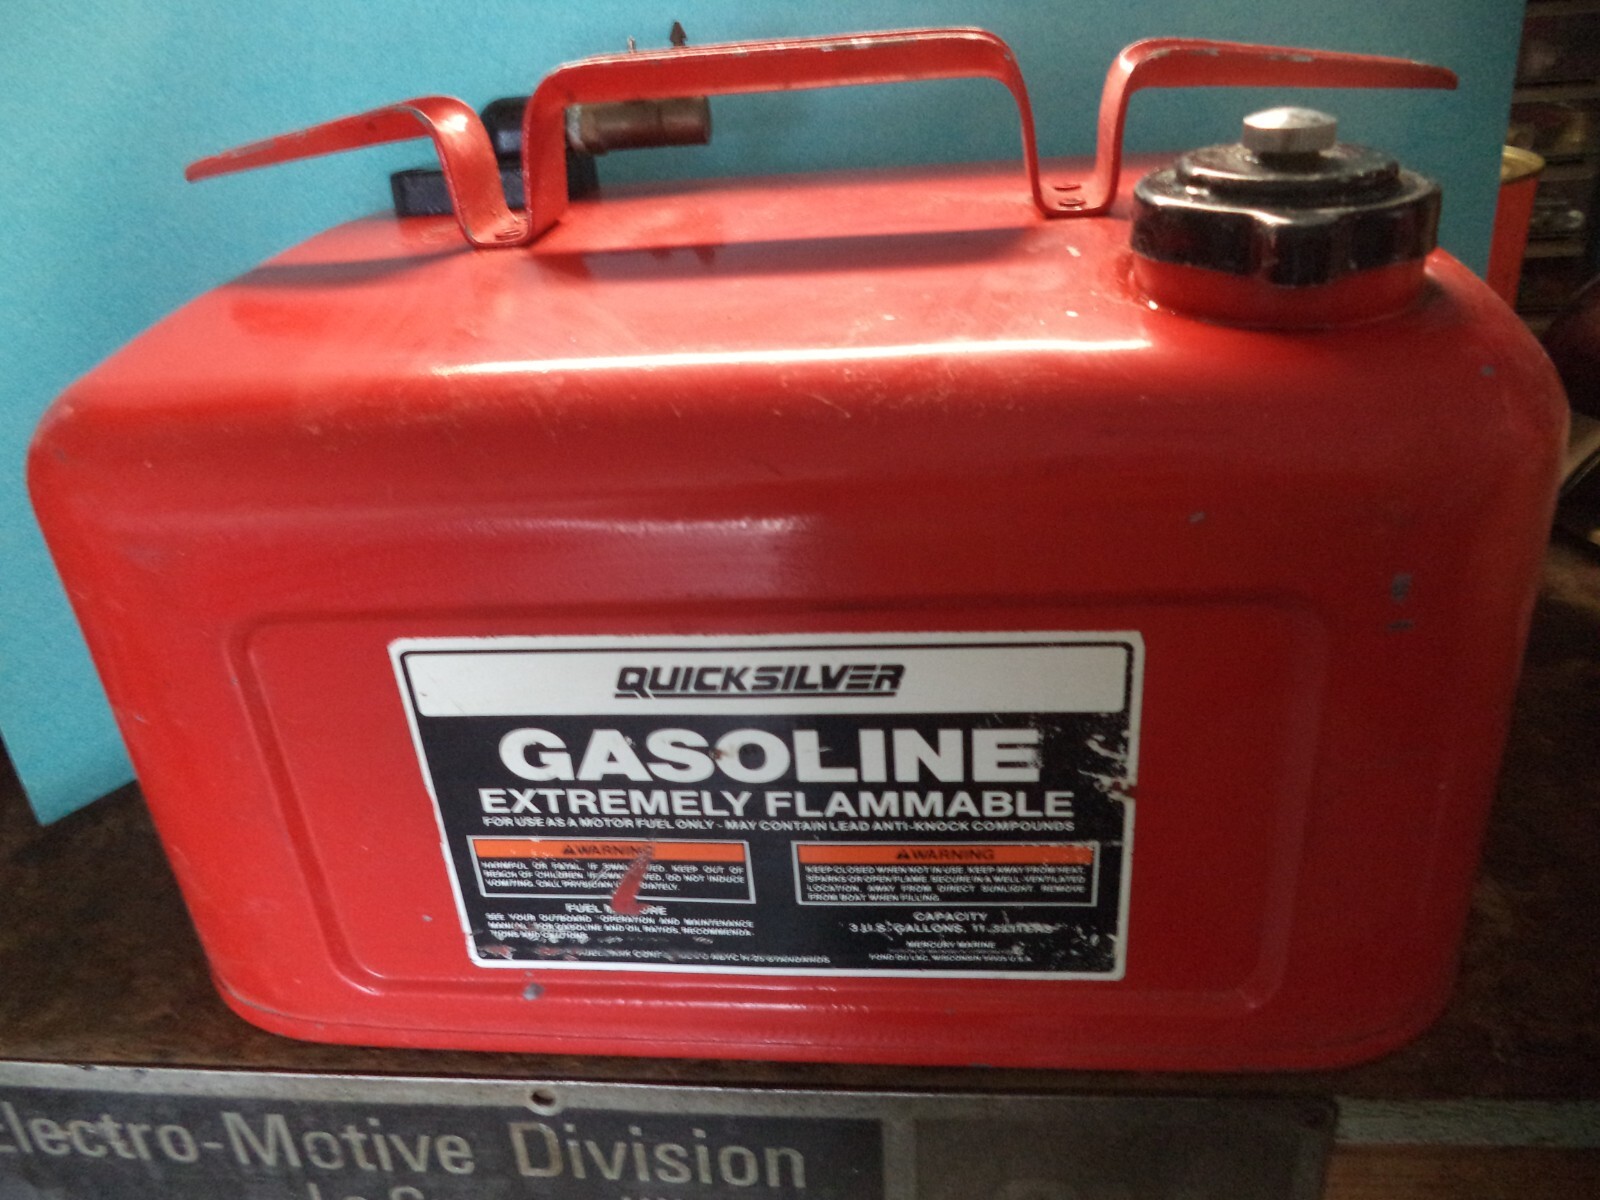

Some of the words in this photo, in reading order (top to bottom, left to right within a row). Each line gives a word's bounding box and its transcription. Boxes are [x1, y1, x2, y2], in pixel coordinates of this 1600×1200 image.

[615, 664, 905, 699] QUICKSILVER
[499, 727, 1040, 784] GASOLINE
[478, 788, 752, 817] EXTREMELY
[763, 790, 1075, 818] FLAMMABLE
[482, 816, 514, 827] FOR
[514, 816, 545, 828] USE
[545, 817, 566, 828] AS
[567, 817, 578, 828] A
[578, 817, 634, 829] MOTOR
[635, 818, 674, 830] FUEL
[674, 818, 715, 830] ONLY
[724, 819, 757, 831] MAY
[758, 819, 828, 832] CONTAIN
[829, 820, 870, 832] LEAD
[871, 820, 969, 832] ANTI-KNOCK
[970, 820, 1075, 832] COMPOUNDS
[911, 849, 994, 860] WARNING
[805, 865, 833, 874] KEEP
[565, 903, 602, 914] FUEL
[912, 911, 988, 921] CAPACITY
[848, 923, 858, 933] 3
[906, 941, 955, 949] MERCURY
[956, 941, 997, 949] MARINE
[508, 1120, 807, 1189] Division
